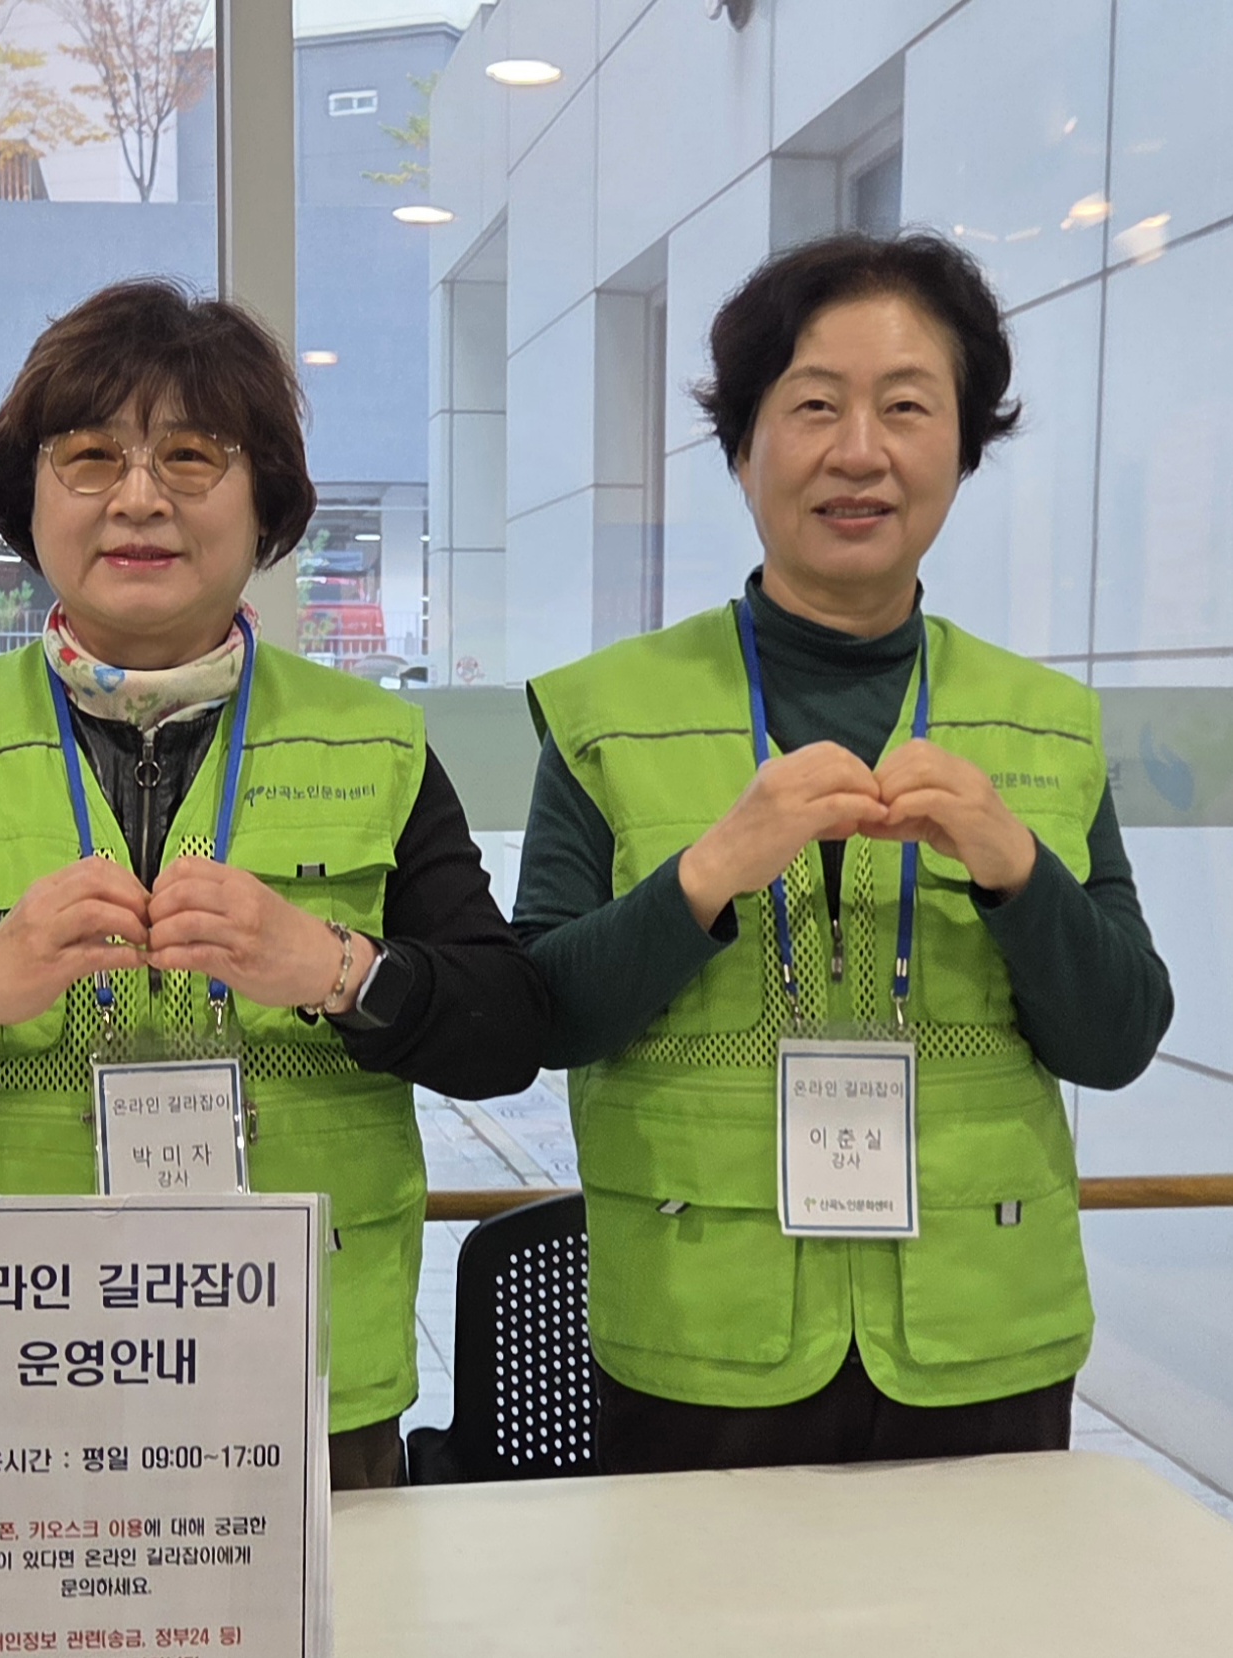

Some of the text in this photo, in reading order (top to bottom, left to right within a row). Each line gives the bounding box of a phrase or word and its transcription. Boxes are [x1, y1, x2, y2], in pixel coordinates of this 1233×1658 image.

[990, 772, 1060, 789] 인문화센터
[793, 1080, 904, 1099] 온라인 길라잡이
[112, 1093, 230, 1116] 온라인 길라잡이
[831, 1151, 861, 1170] 강사
[158, 1169, 189, 1188] 강사
[98, 1261, 276, 1310] 길라잡이
[17, 1337, 197, 1388] 운영안내
[82, 1445, 129, 1473] 평일
[141, 1444, 281, 1470] 09:00~17:00
[28, 1519, 99, 1540] 키오스크
[108, 1517, 161, 1539] 이용에
[170, 1516, 205, 1537] 대해
[214, 1515, 267, 1537] 궁금한
[22, 1549, 75, 1570] 있다면
[84, 1547, 137, 1568] 온라인
[146, 1545, 251, 1567] 길라잡이에게
[60, 1576, 153, 1599] 문의하세요.
[155, 1627, 210, 1648] 정부24
[219, 1625, 242, 1646] 등)
